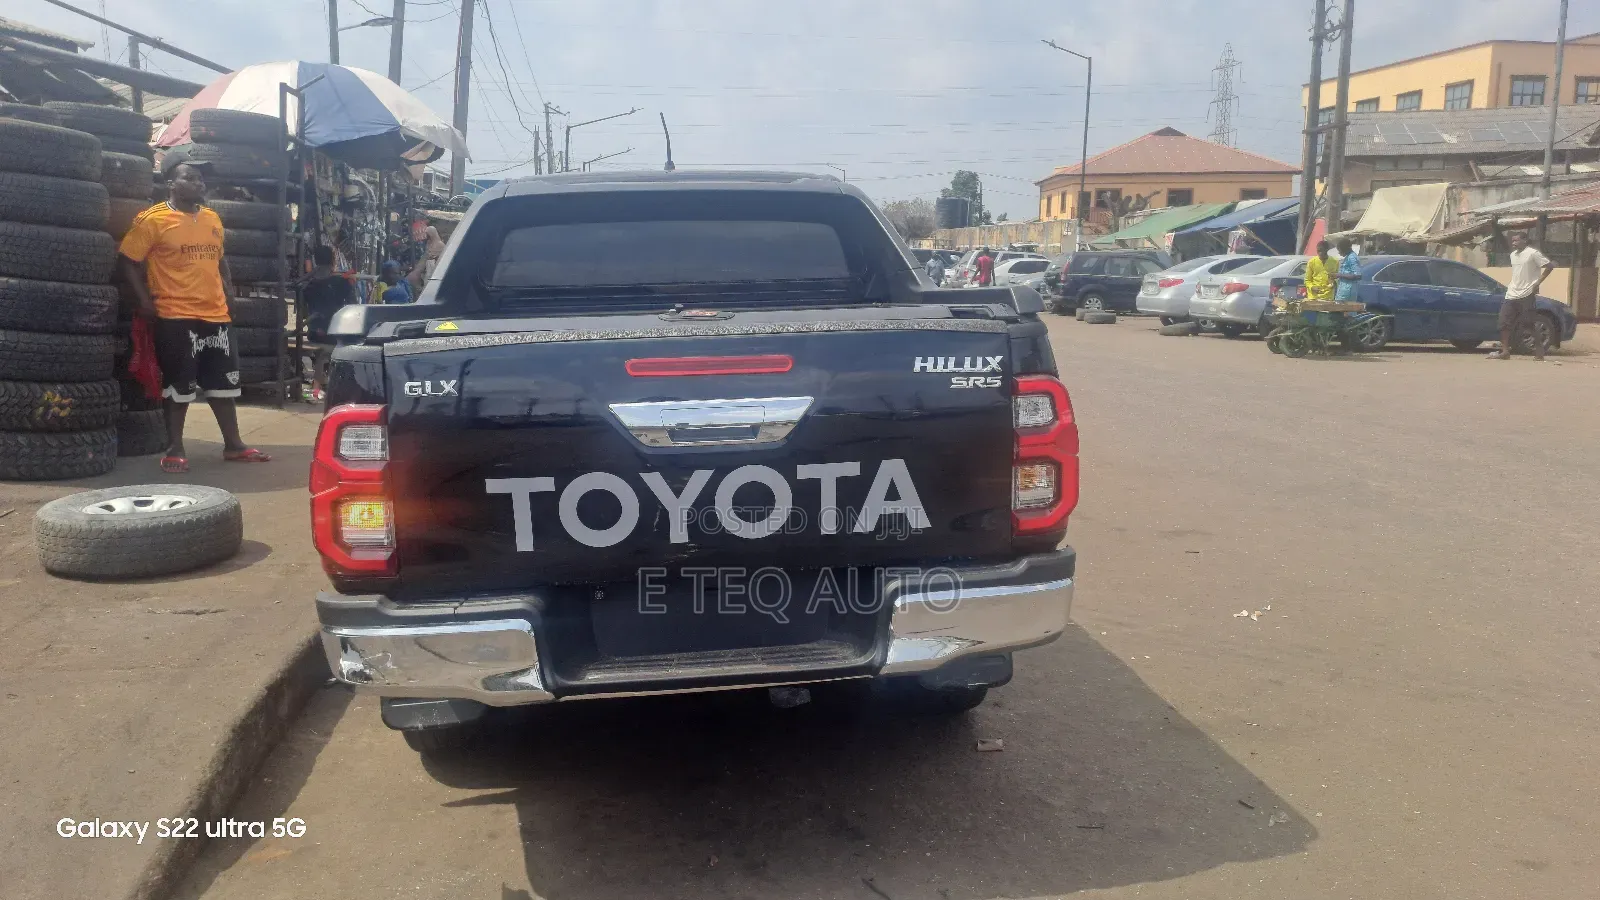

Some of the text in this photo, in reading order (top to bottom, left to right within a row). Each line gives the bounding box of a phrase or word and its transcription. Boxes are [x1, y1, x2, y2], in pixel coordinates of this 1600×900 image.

[180, 243, 220, 253] Emirates
[913, 355, 1004, 373] HILUX
[404, 380, 459, 397] GLX
[485, 458, 932, 552] TOYOTA
